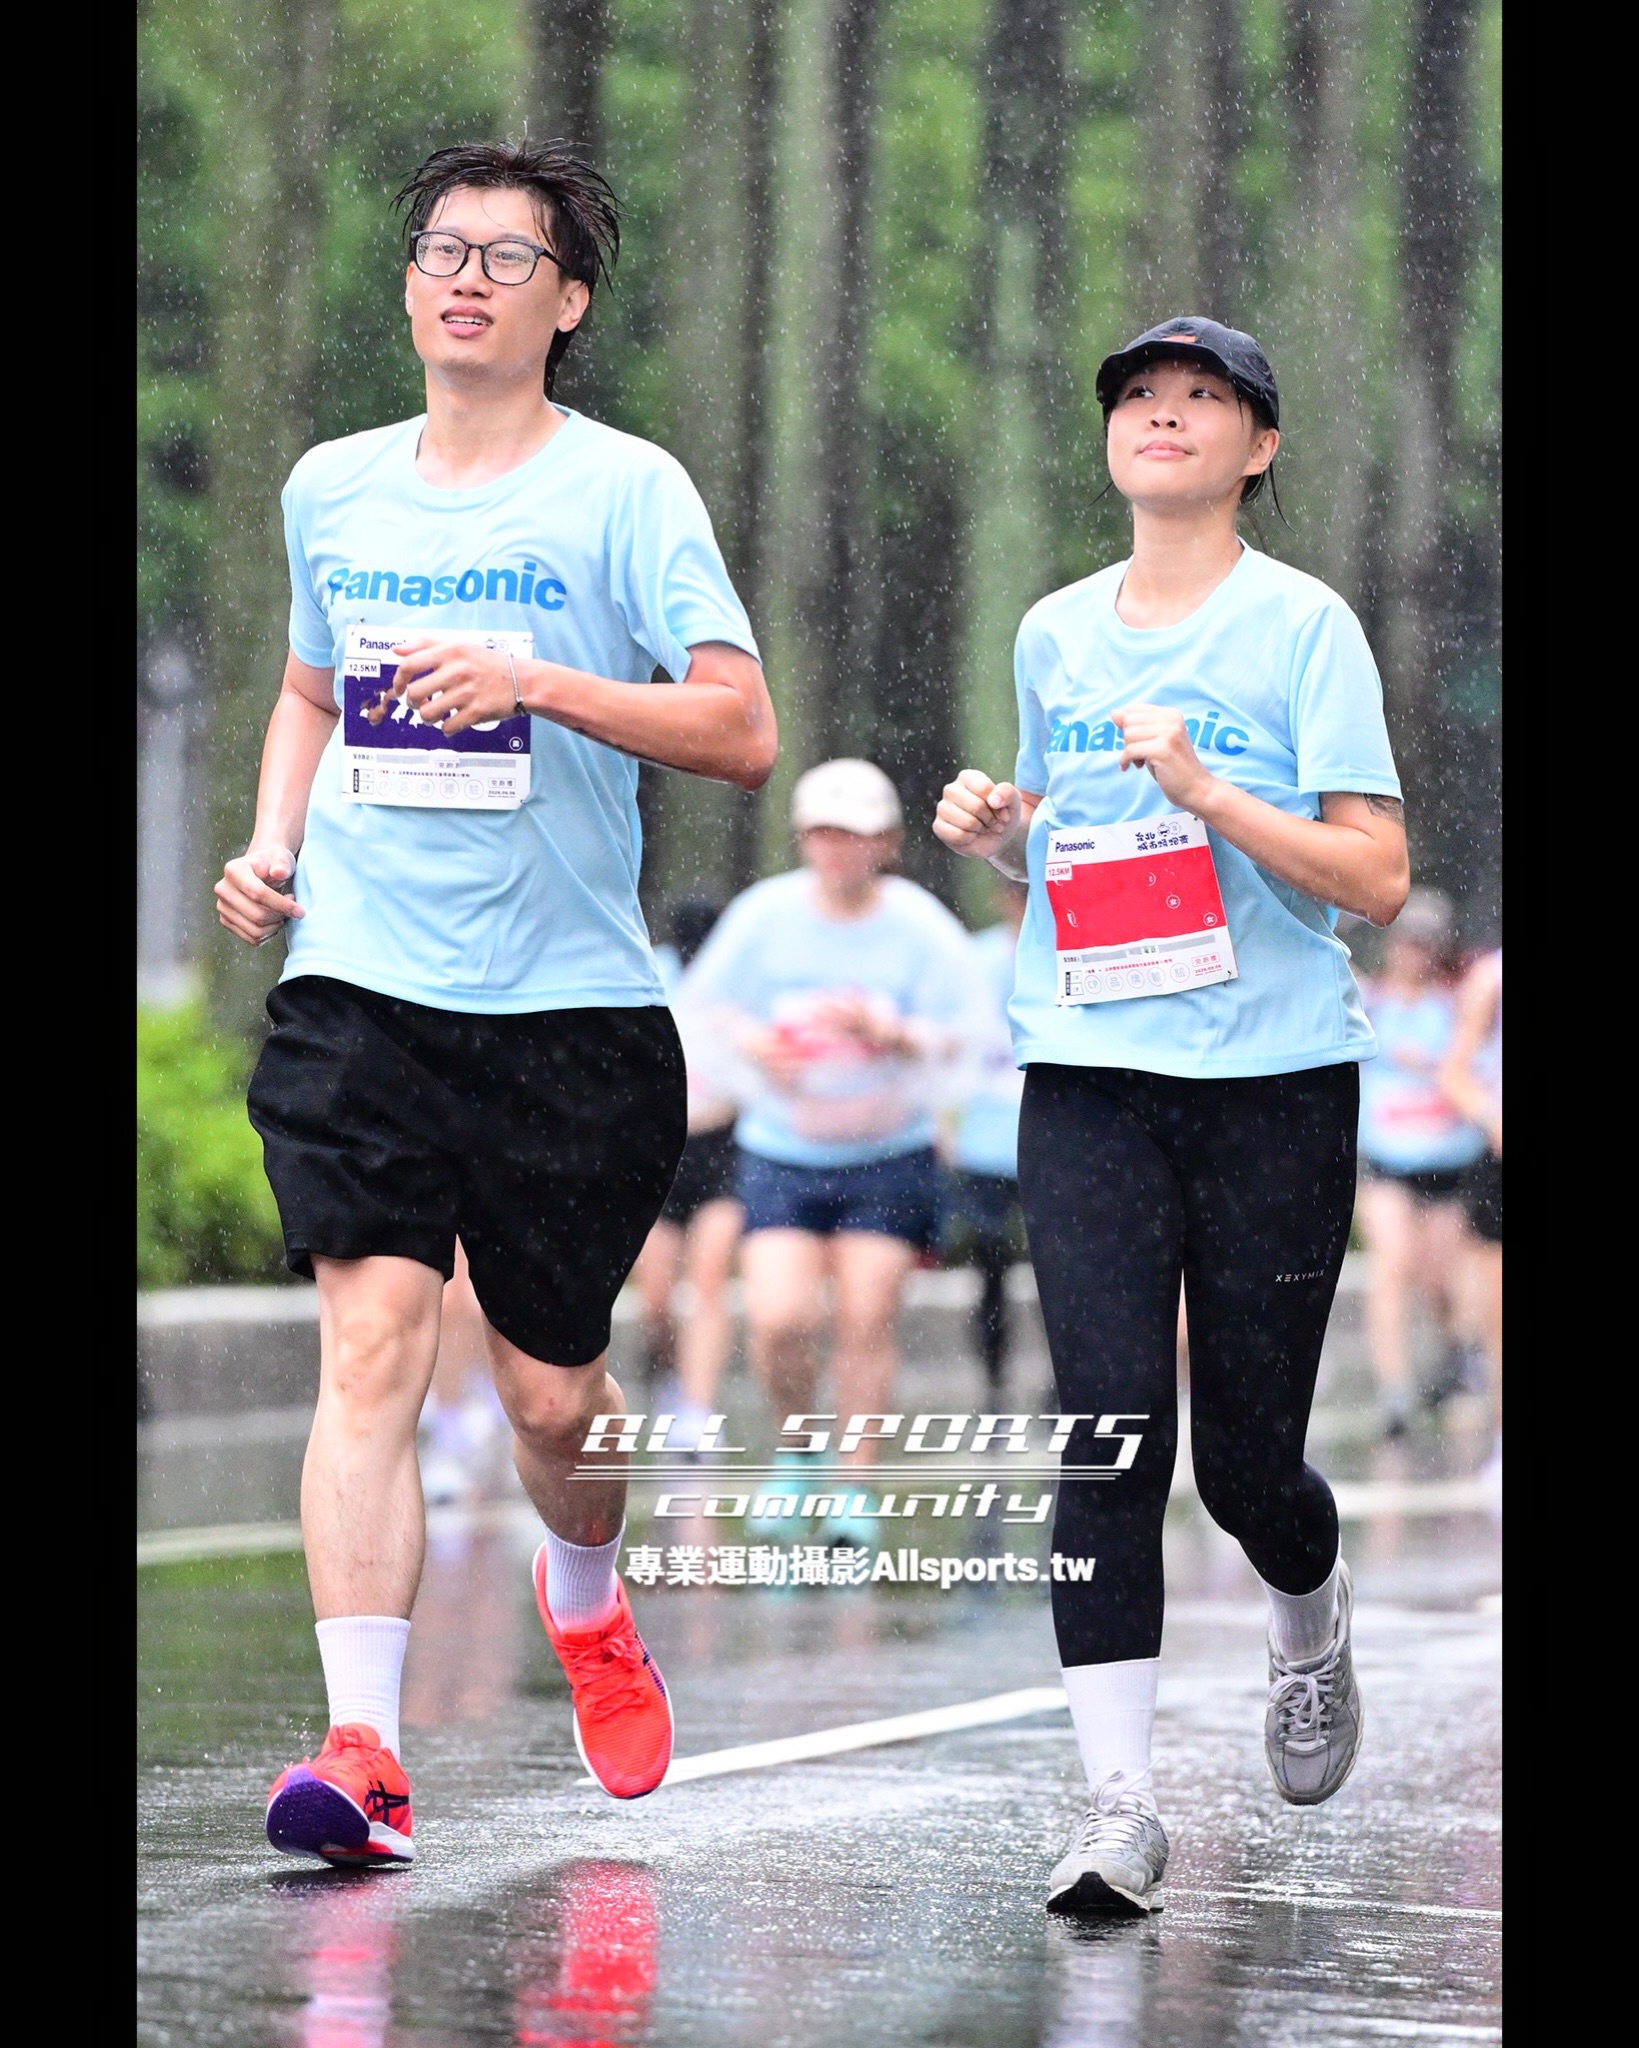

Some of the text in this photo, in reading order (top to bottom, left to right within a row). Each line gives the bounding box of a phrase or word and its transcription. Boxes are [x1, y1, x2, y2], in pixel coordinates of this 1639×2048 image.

[327, 561, 567, 612] Panasonic
[350, 664, 377, 672] 12.5KM
[1056, 839, 1096, 852] Panasonic
[1049, 867, 1070, 876] 12.5KM
[1275, 1269, 1325, 1282] XEXYMIX
